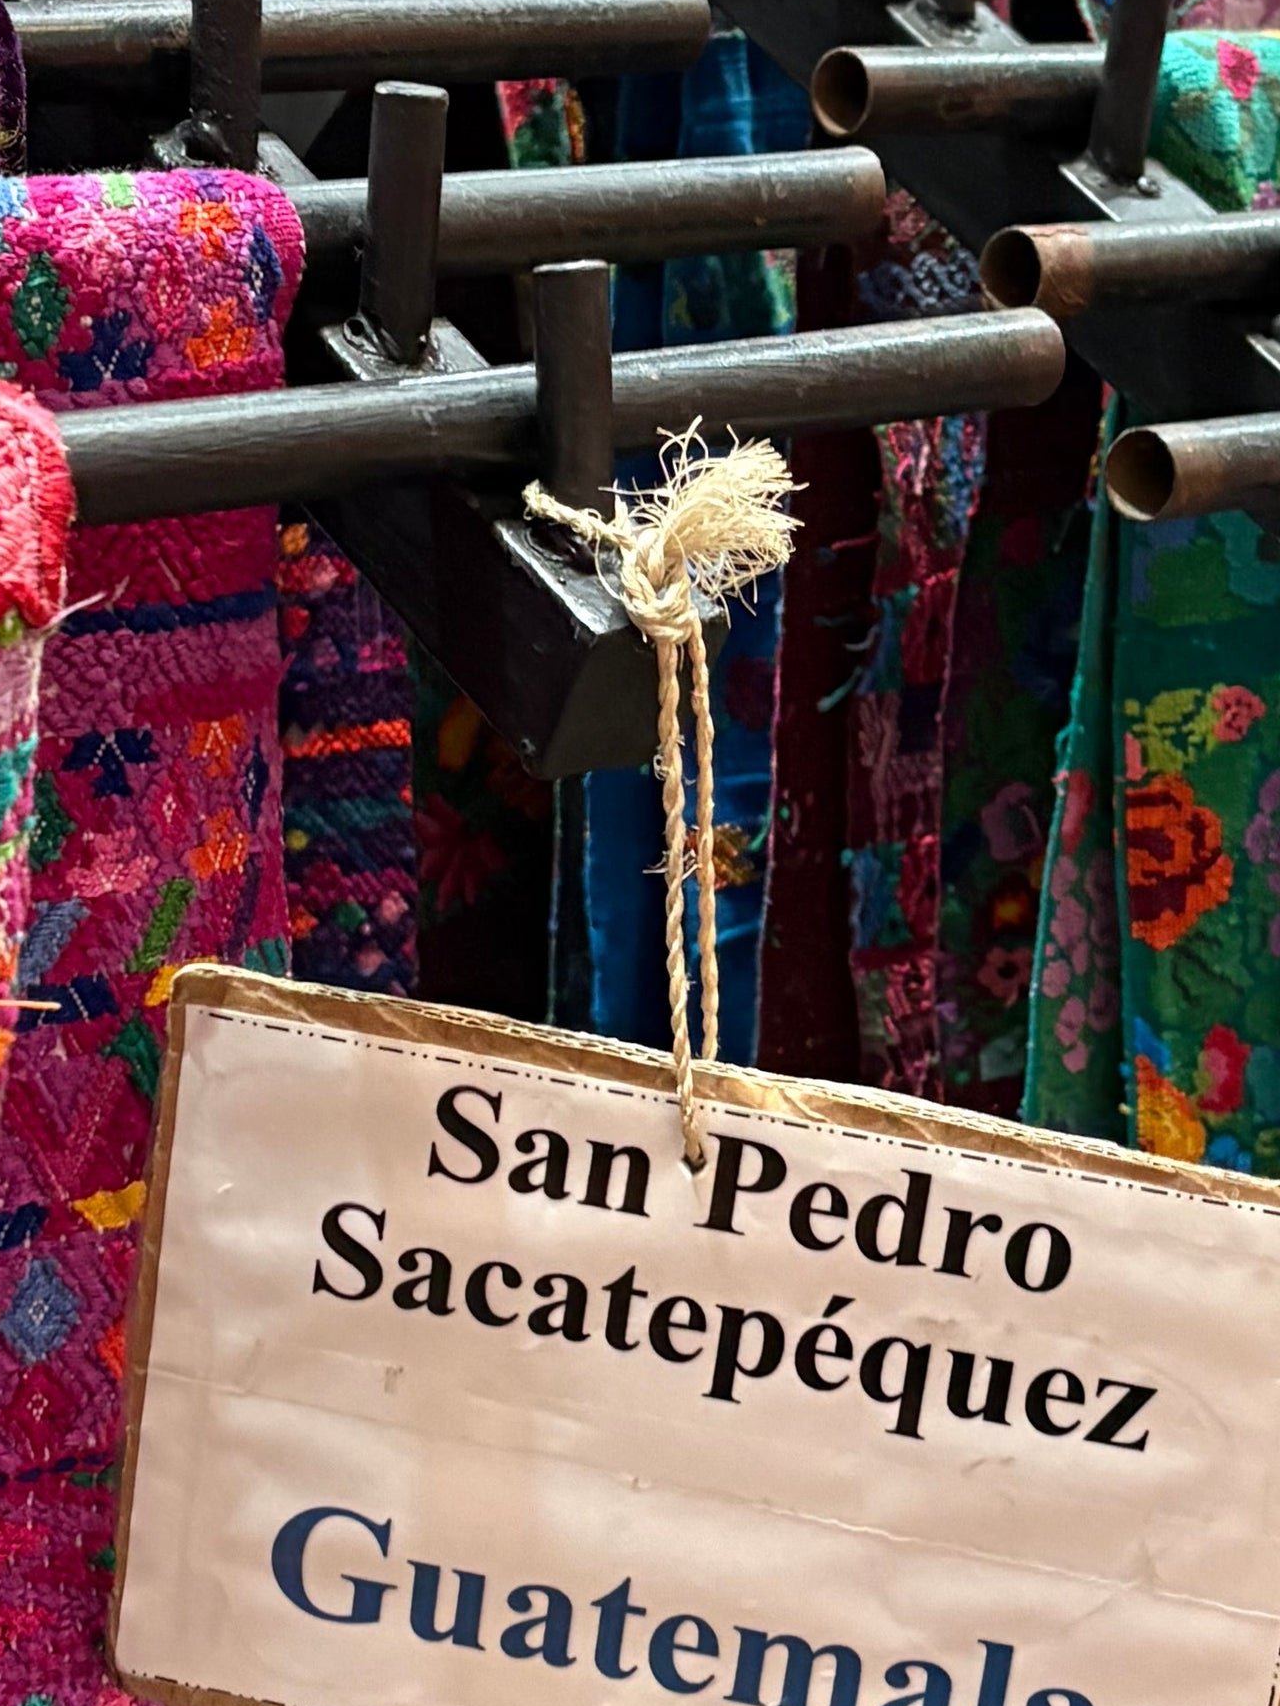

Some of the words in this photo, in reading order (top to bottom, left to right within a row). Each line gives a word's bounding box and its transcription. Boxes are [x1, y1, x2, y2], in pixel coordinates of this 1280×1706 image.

[427, 1085, 651, 1218] San
[693, 1132, 1072, 1293] Pedro
[312, 1202, 1158, 1452] Sacatepéquez
